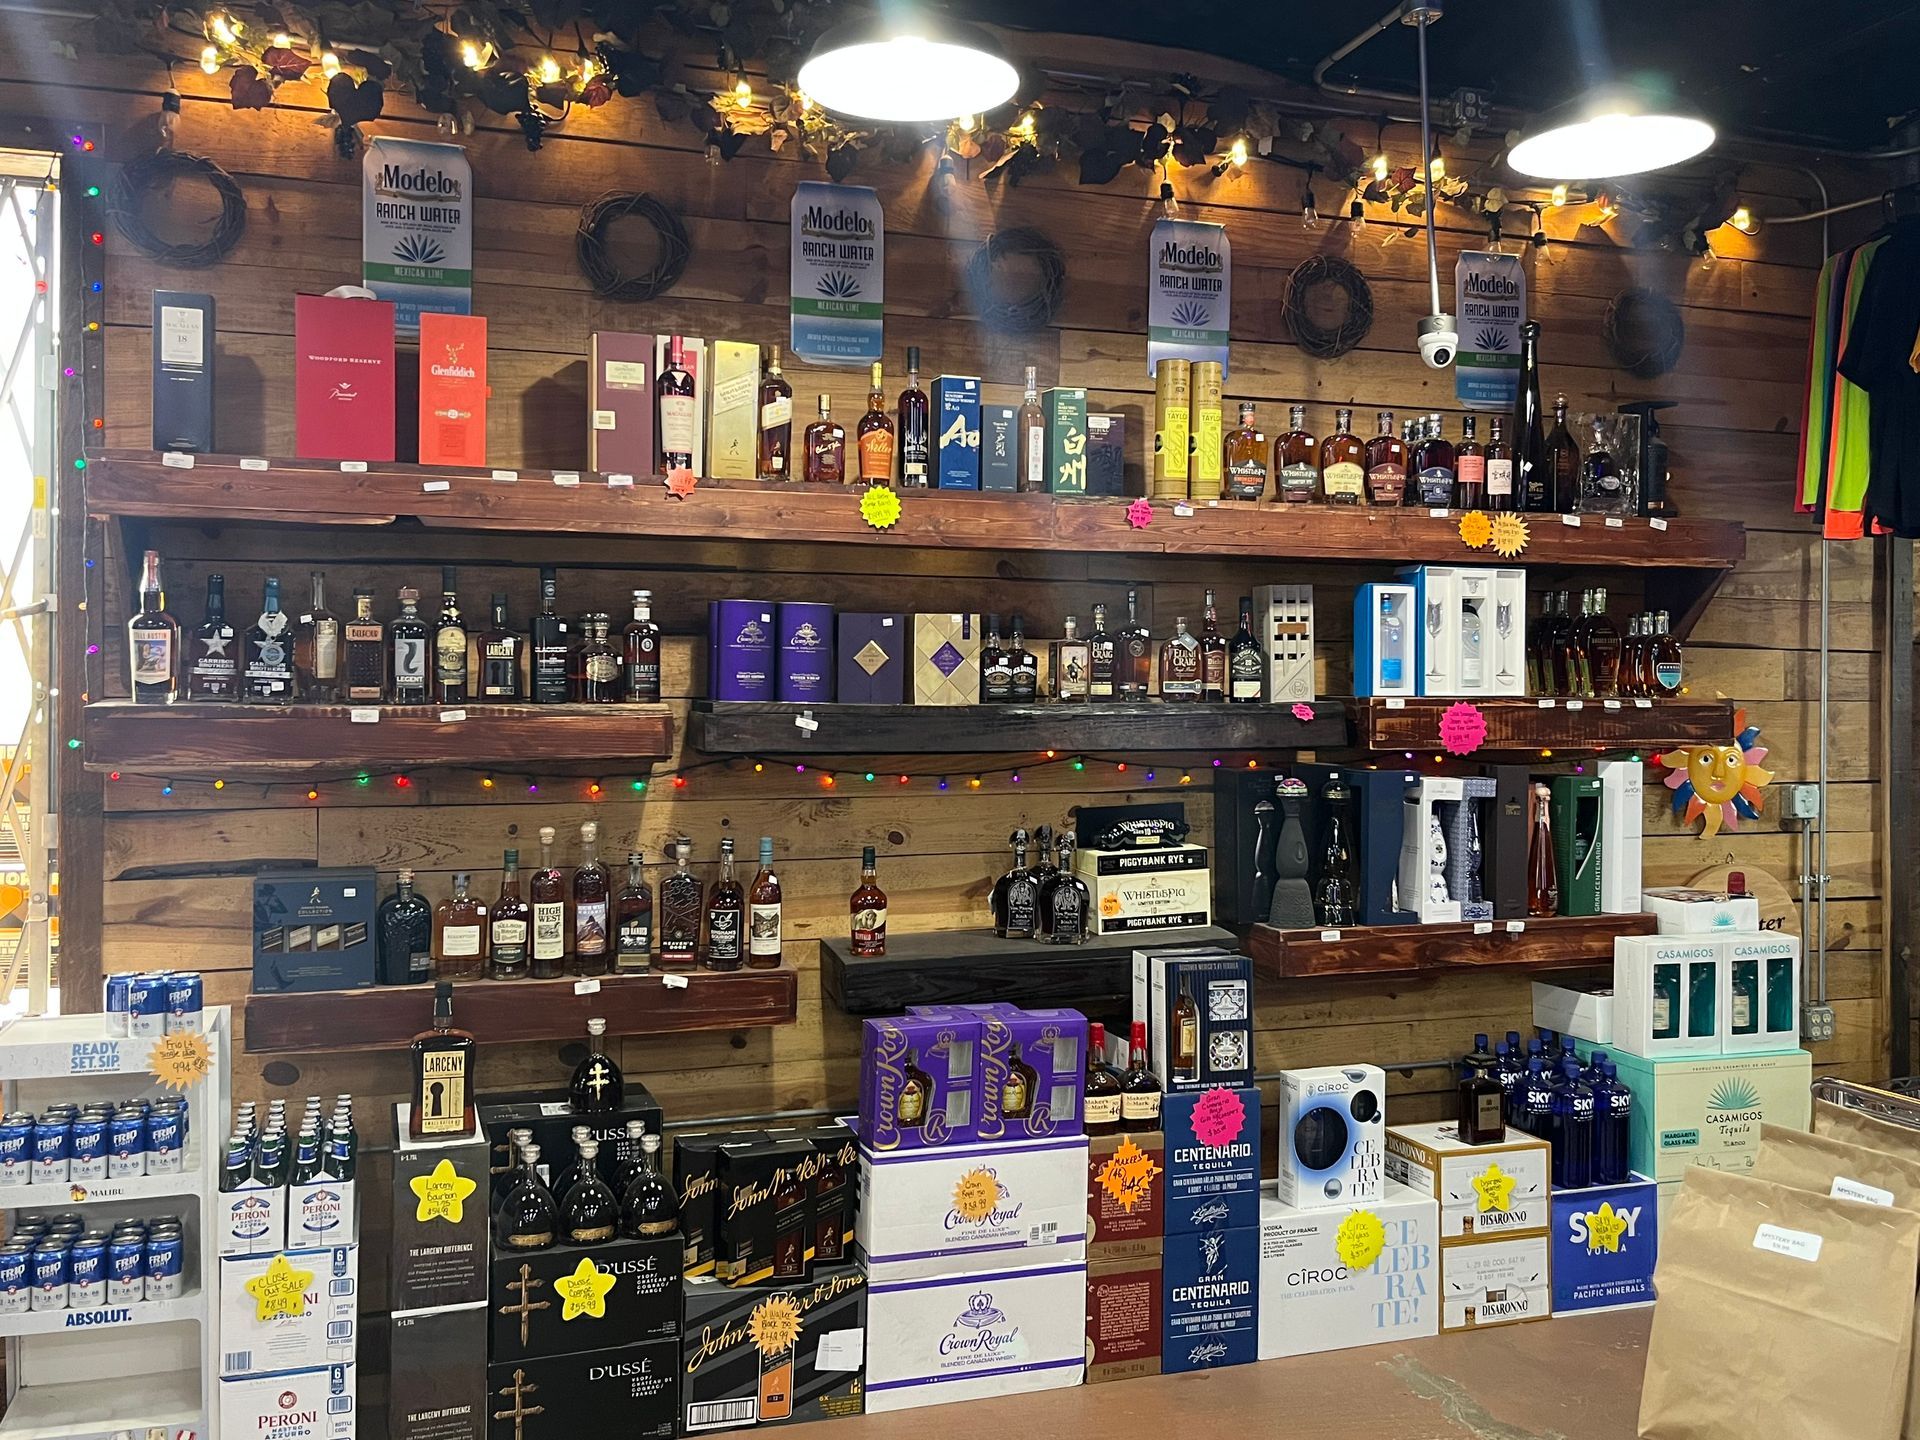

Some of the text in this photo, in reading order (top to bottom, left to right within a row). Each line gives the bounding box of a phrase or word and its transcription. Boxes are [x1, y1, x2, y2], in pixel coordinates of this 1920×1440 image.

[382, 164, 453, 194] Modelo
[376, 203, 461, 225] RANCH WATER
[808, 206, 868, 235] Modelo
[802, 241, 874, 262] RANCH WATER
[1164, 241, 1218, 268] Modelo
[393, 267, 445, 281] MEXICAN LIME
[1159, 275, 1223, 293] RANCH WATER
[1468, 272, 1516, 296] Modelo
[816, 299, 861, 313] MEXICAN LIME
[1464, 303, 1520, 319] RANCH WATER
[177, 335, 188, 343] 18
[1171, 329, 1197, 341] MEXICAN
[308, 355, 382, 366] WOODFORD RESERVE
[1475, 354, 1495, 363] MEXICAN
[431, 365, 476, 379] Glenfiddich
[940, 414, 979, 448] Ao
[352, 629, 379, 638] BELFOUR
[1091, 650, 1113, 659] CRAIG
[1173, 656, 1196, 666] CRAIG
[1118, 819, 1175, 832] WHISTLEPIG
[1119, 854, 1184, 867] PIGGYBANK RYE
[1593, 842, 1602, 913] GRAN CENTENARIO
[1123, 888, 1186, 901] WHISTLEPIG
[538, 907, 561, 915] HIGH
[538, 914, 561, 922] WEST
[1127, 915, 1183, 927] PIGGYBANK RYE
[1656, 948, 1714, 960] CASAMIGOS
[1734, 944, 1791, 957] CASAMIGOS
[169, 988, 192, 1002] FRIO
[72, 1041, 120, 1056] READY.
[70, 1054, 120, 1069] SET. SIP.
[424, 1056, 463, 1073] LARCENY
[1705, 1111, 1763, 1124] CASAMIGOS
[113, 1129, 138, 1144] FRIO
[152, 1124, 177, 1140] FRIO
[1664, 1131, 1697, 1140] MARGARITA
[1718, 1124, 1751, 1136] Tequila
[0, 1137, 25, 1151] FRIO
[37, 1135, 63, 1150] FRIO
[75, 1133, 101, 1147] FRIO
[1354, 1139, 1375, 1154] CE
[1663, 1137, 1697, 1147] GLASS PACK
[1174, 1144, 1251, 1163] CENTENARIO
[1388, 1134, 1426, 1164] DISARONNO
[1113, 1153, 1143, 1167] MAKERS
[1192, 1161, 1233, 1171] TEQUILA
[1350, 1153, 1381, 1169] LEB
[1357, 1168, 1379, 1183] RA
[90, 1188, 125, 1197] MALIBU
[1349, 1181, 1376, 1197] TE!
[1837, 1185, 1879, 1205] MYSTERY BAG
[427, 1192, 457, 1202] Bourbon
[302, 1203, 341, 1214] PERONI
[231, 1210, 270, 1222] PERONI
[944, 1202, 1023, 1230] Crown Royal
[1480, 1210, 1527, 1226] DISARONNO
[969, 1233, 996, 1241] CANADIAN
[995, 1230, 1021, 1239] WHISKY
[1263, 1230, 1289, 1238] PRODUCT
[1297, 1226, 1318, 1234] FRANCE
[1380, 1219, 1419, 1248] CE
[1761, 1231, 1806, 1248] MYSTERY BAG
[336, 1249, 343, 1262] 6
[409, 1243, 473, 1257] THE LARCENY DIFFERENCE
[73, 1257, 98, 1272] FRIO
[115, 1253, 140, 1269] FRIO
[148, 1251, 172, 1265] FRIO
[1370, 1244, 1431, 1276] LEB
[0, 1264, 26, 1281] FRIO
[36, 1261, 62, 1276] FRIO
[258, 1272, 289, 1289] CLOSE
[1198, 1274, 1224, 1283] GRAN
[1287, 1267, 1348, 1287] CÎROC
[282, 1279, 305, 1293] SALE
[637, 1287, 663, 1295] FRANCE
[825, 1274, 865, 1301] Sons
[1172, 1281, 1250, 1303] CENTENARIO
[1280, 1285, 1355, 1300] THE CELEBRATION PACK
[1385, 1272, 1427, 1301] RA
[1573, 1284, 1646, 1300] PACIFIC MINERALS
[1190, 1298, 1231, 1309] TEQUILA
[1482, 1300, 1529, 1317] DISARONNO
[65, 1308, 133, 1327] ABSOLUT.
[1371, 1297, 1420, 1328] TE!
[939, 1326, 1020, 1356] Crown Royal
[965, 1359, 992, 1367] CANADIAN
[992, 1354, 1017, 1363] WHISKY
[334, 1367, 341, 1378] 6
[589, 1357, 653, 1381] D'USSÉ
[631, 1378, 662, 1387] CHATEAU
[631, 1389, 658, 1398] FRANCE
[258, 1410, 318, 1429] PERONI
[407, 1405, 471, 1422] THE LARCENY DIFFERENCE
[265, 1429, 311, 1440] AZZURRO
[272, 1424, 303, 1433] NASTRO
